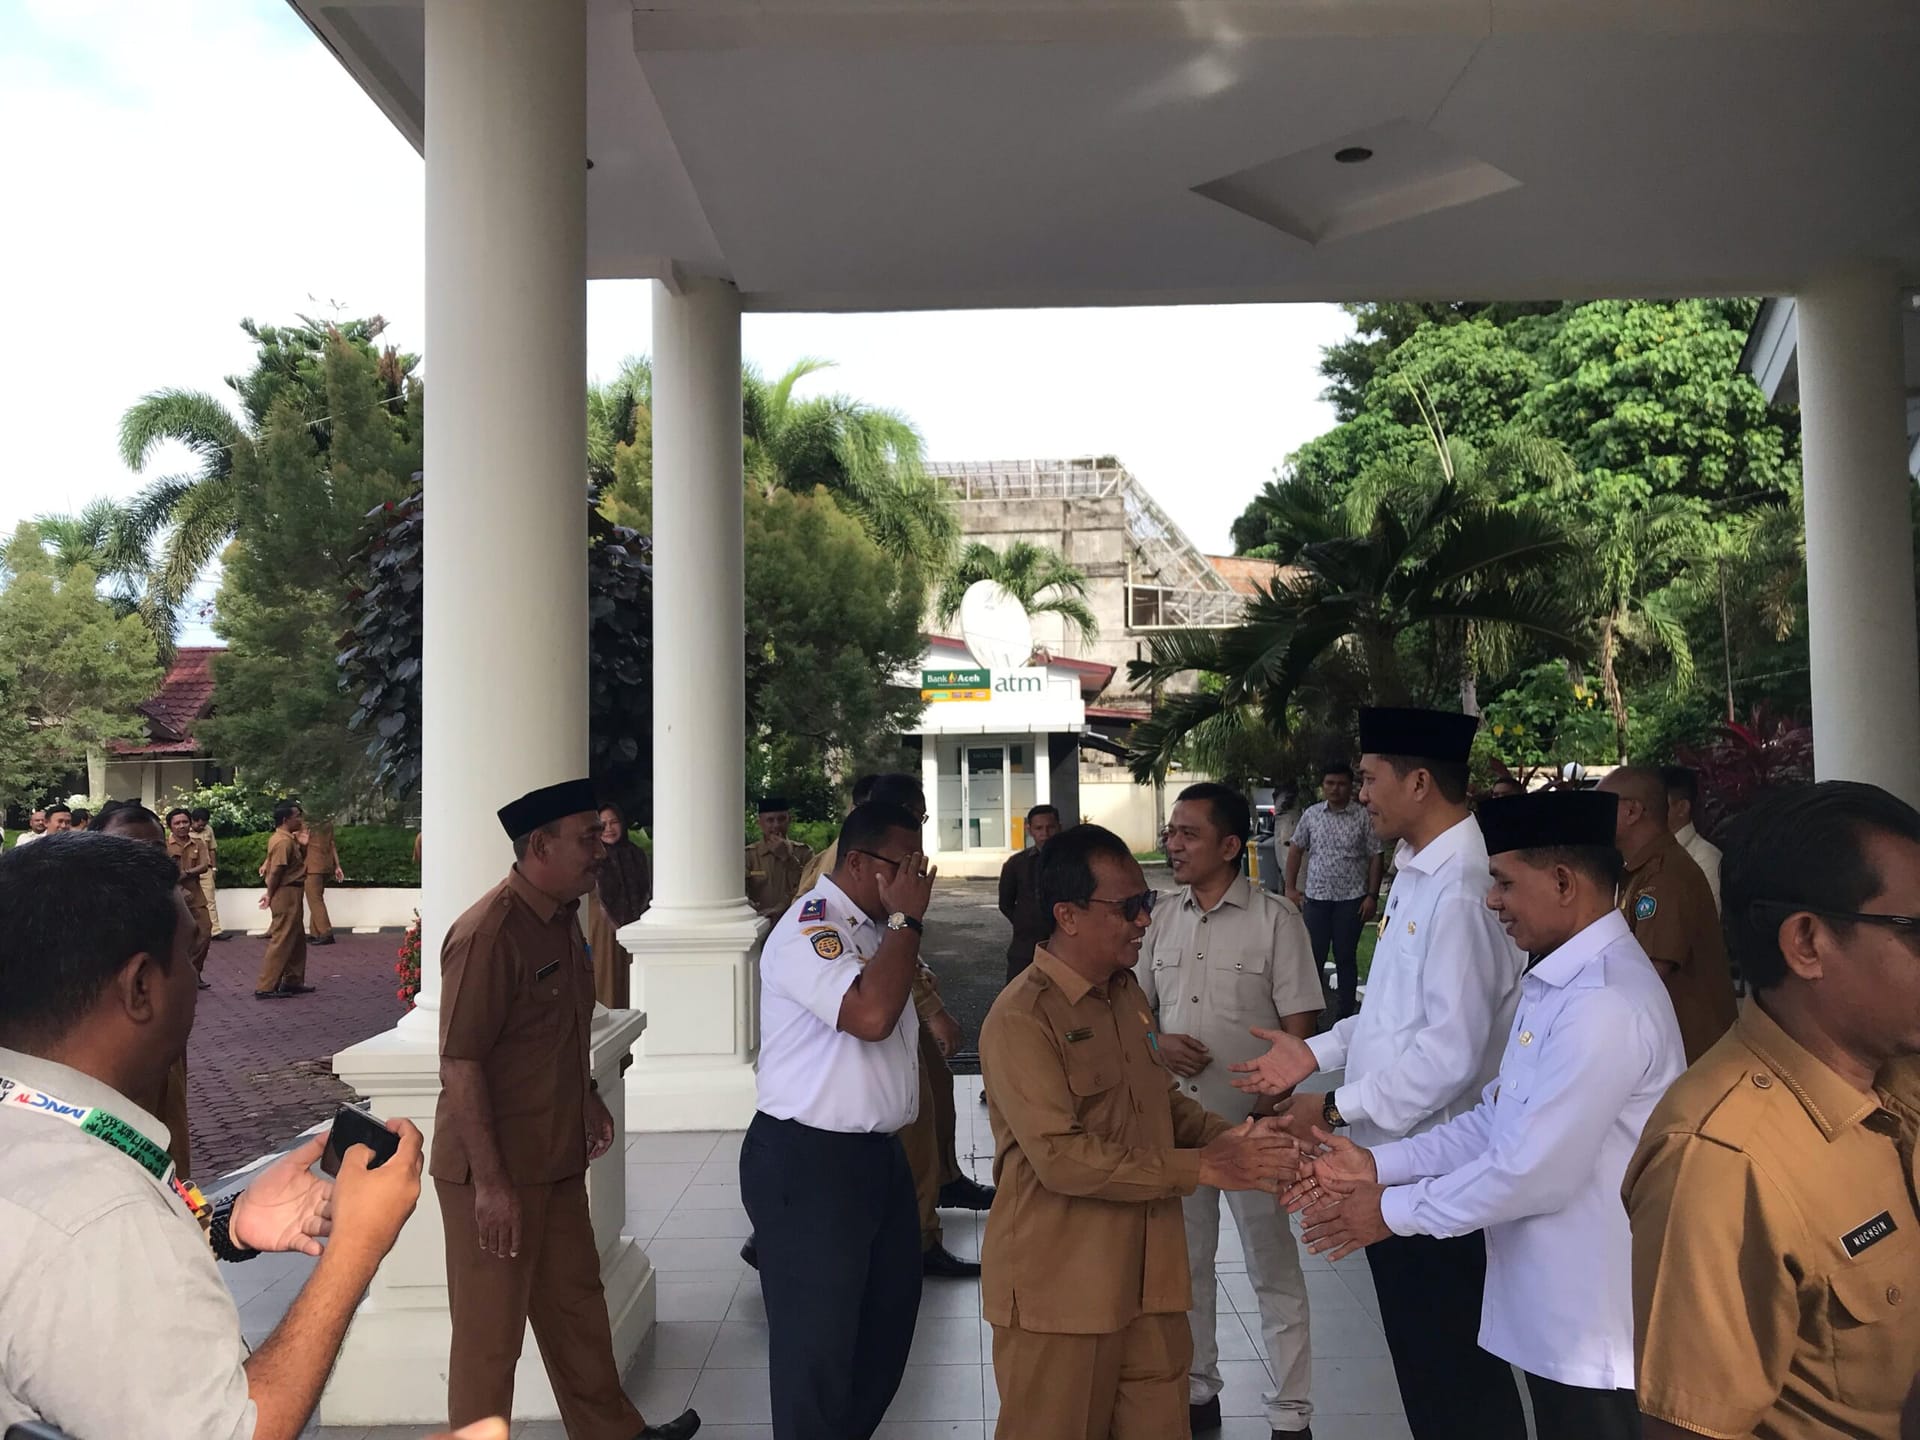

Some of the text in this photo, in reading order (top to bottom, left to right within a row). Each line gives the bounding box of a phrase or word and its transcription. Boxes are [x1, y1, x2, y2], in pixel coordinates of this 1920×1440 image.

[927, 674, 980, 683] Bank Aceh
[995, 674, 1041, 692] atm
[1852, 1221, 1888, 1247] MUCHSIN
